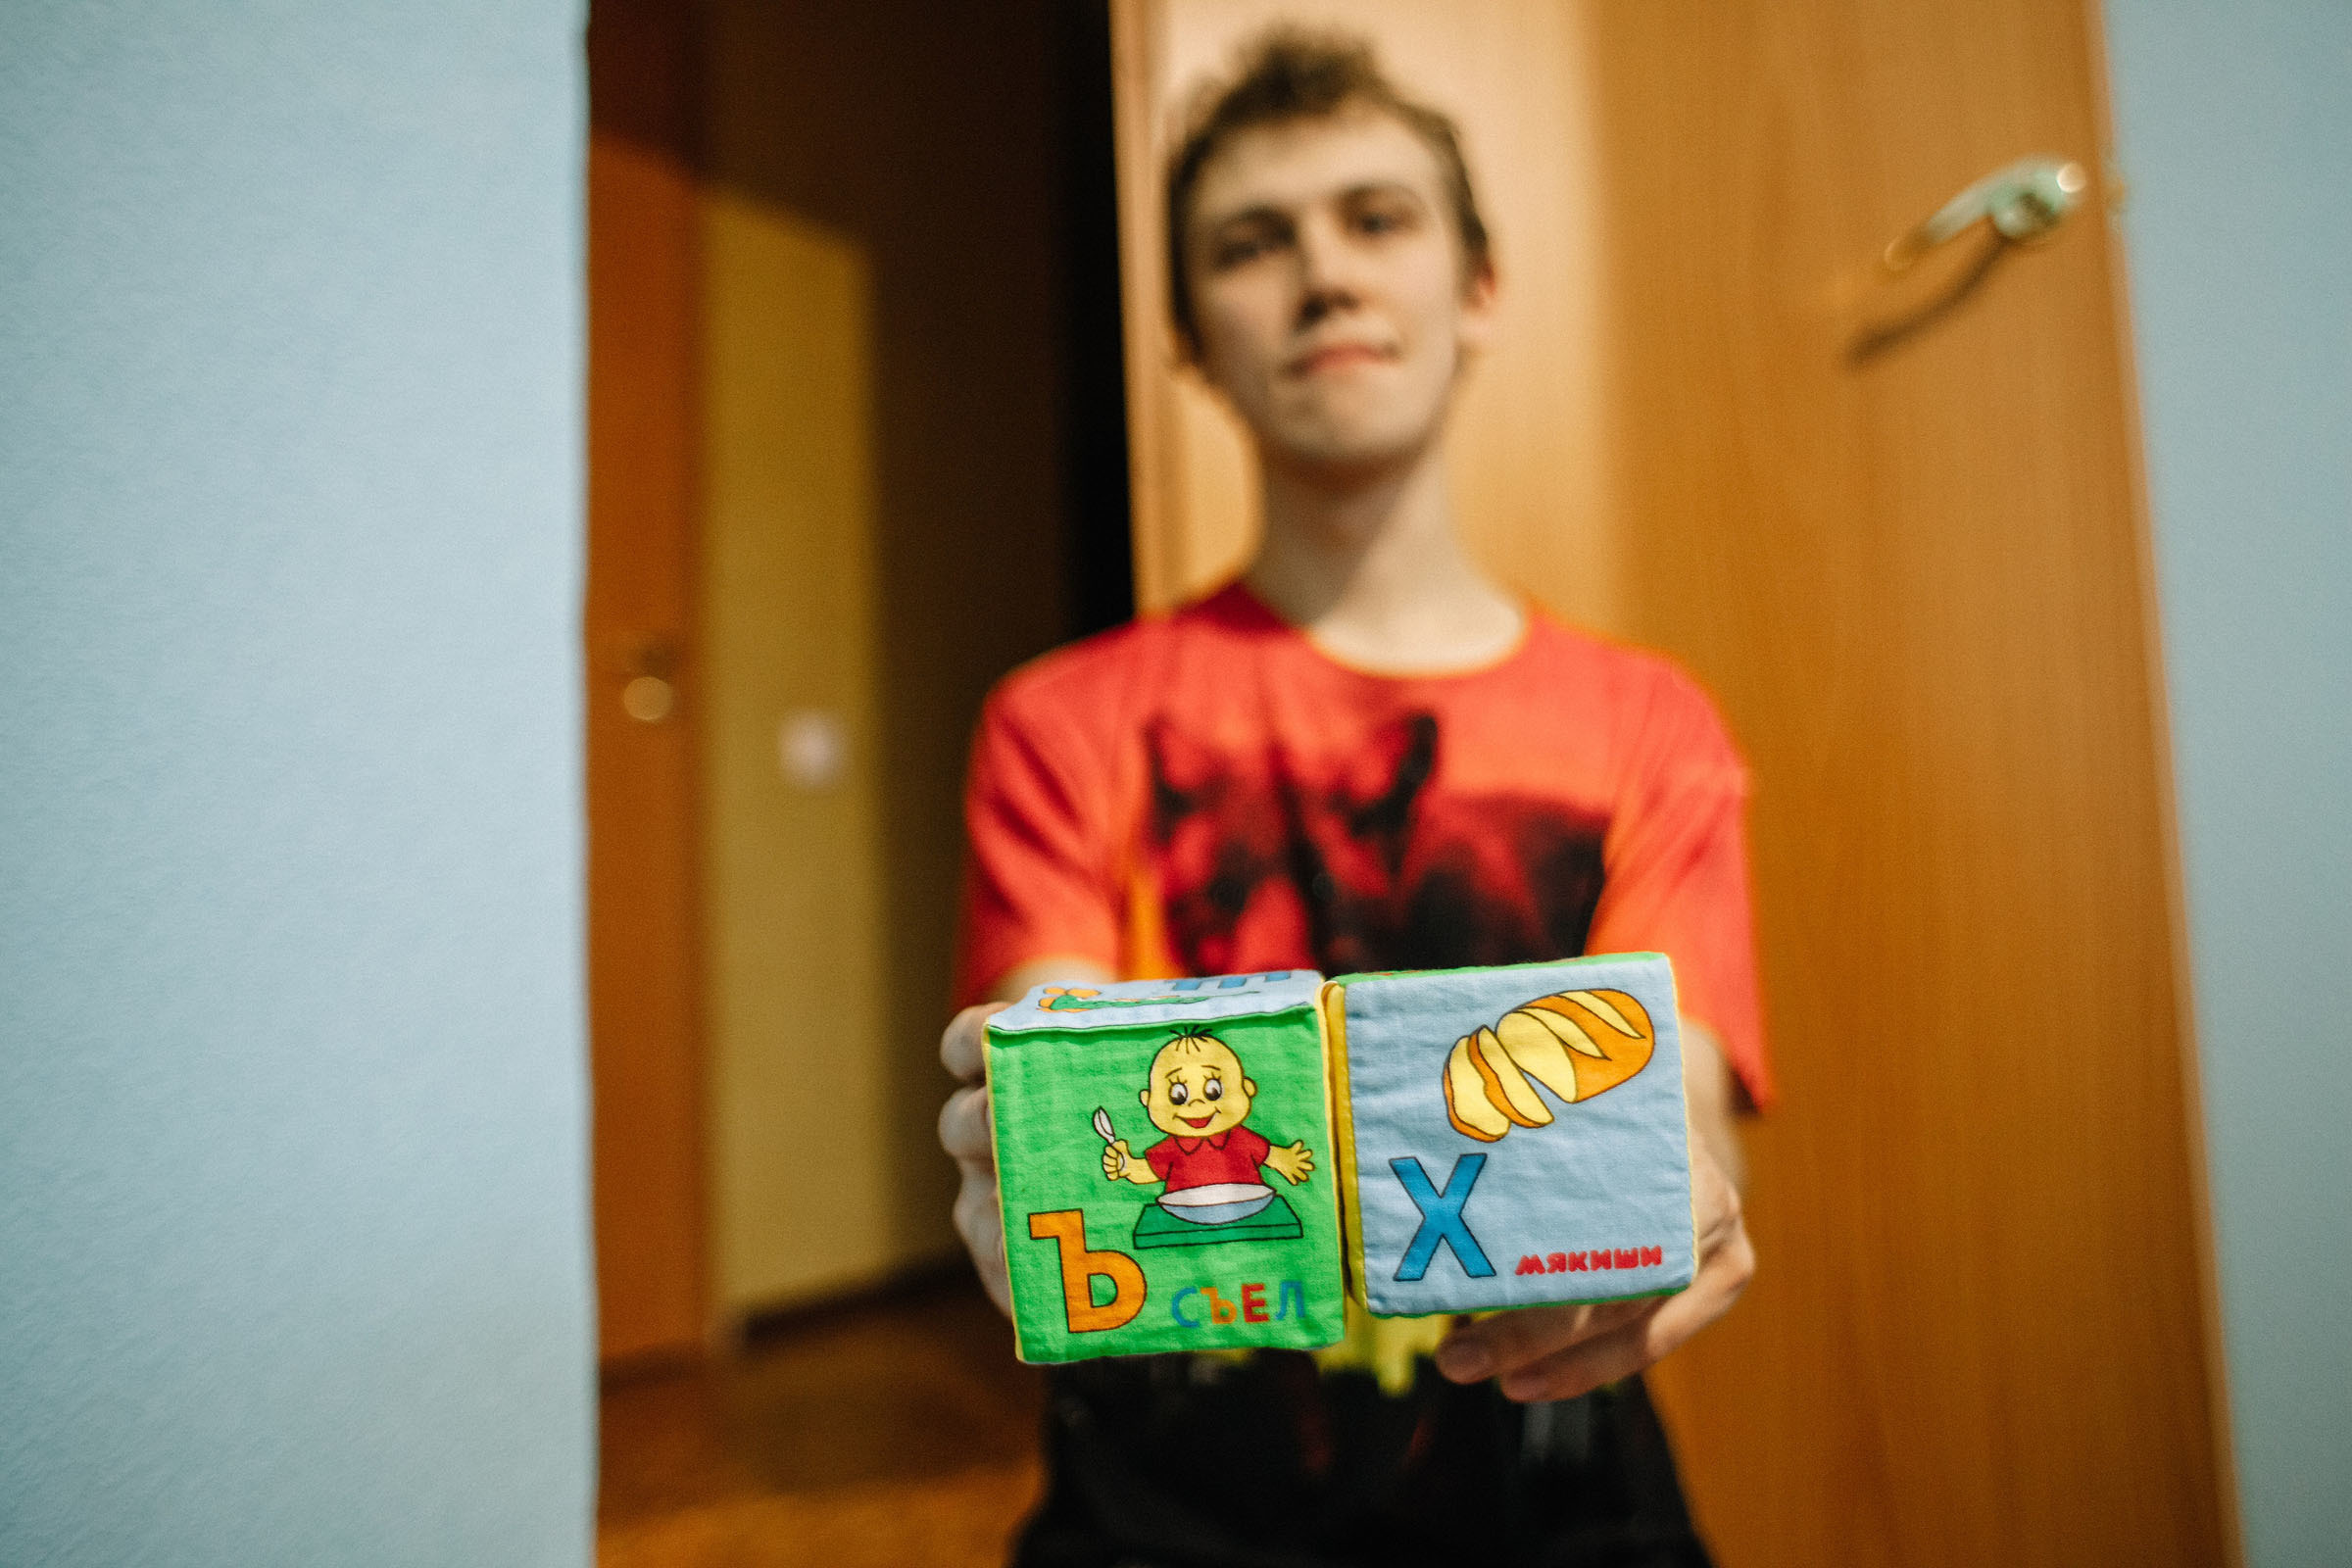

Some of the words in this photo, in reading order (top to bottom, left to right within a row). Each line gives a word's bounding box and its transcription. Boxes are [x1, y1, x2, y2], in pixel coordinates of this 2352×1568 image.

[1389, 1152, 1496, 1282] Х
[1515, 1246, 1662, 1275] МЯКИШИ
[1028, 1208, 1147, 1334] Ъ
[1171, 1280, 1306, 1328] СЪЕЛ
